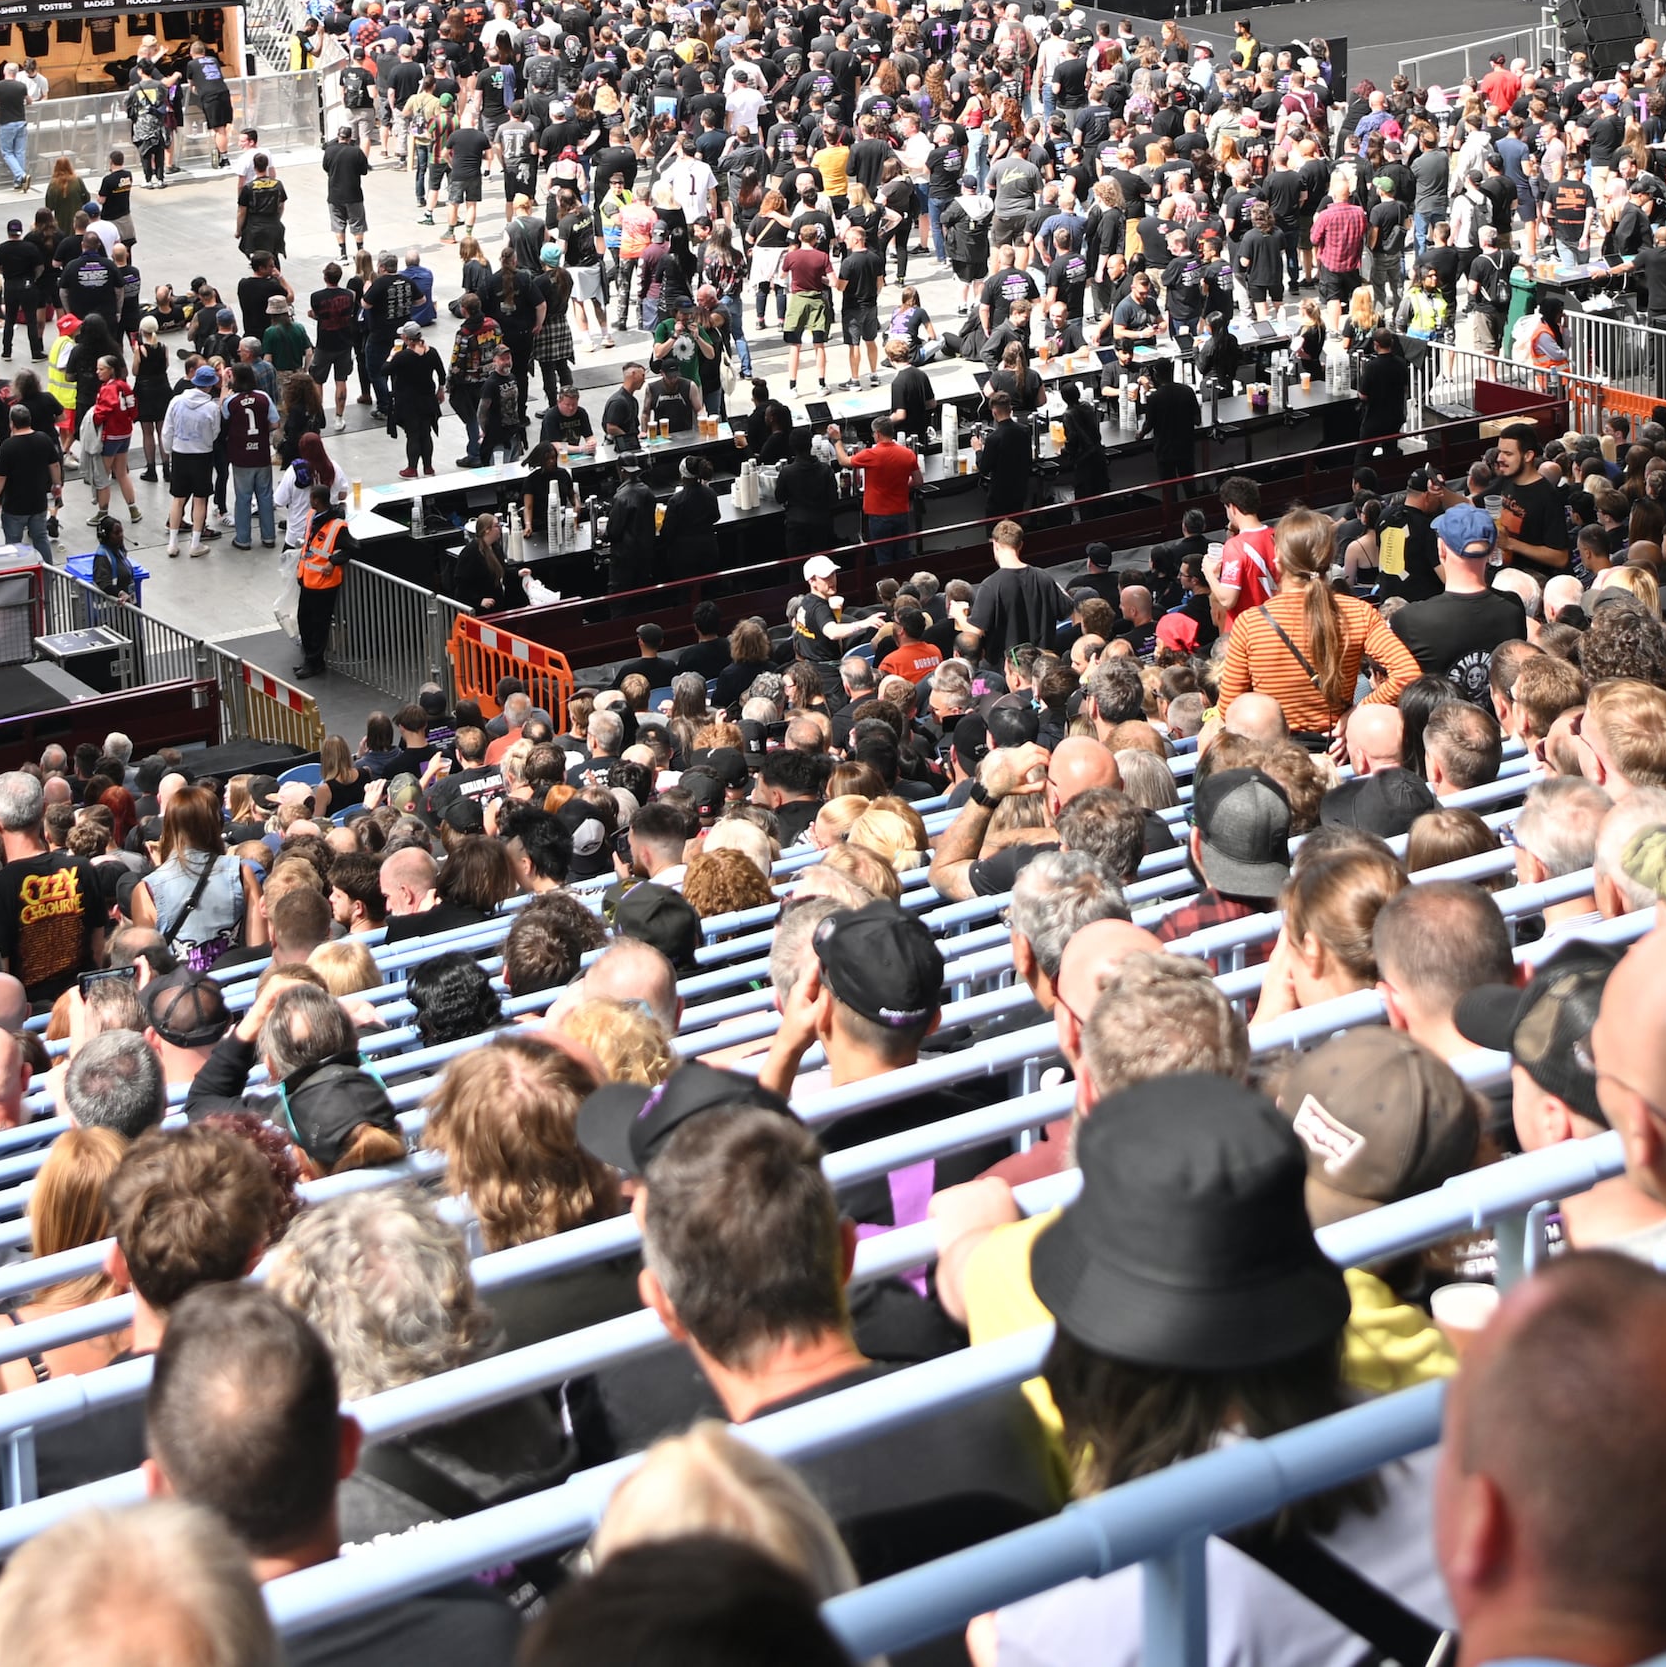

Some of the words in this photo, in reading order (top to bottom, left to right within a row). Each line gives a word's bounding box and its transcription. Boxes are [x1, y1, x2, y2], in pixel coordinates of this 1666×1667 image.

[38, 2, 73, 12] POSTERS
[244, 407, 259, 435] 1
[1457, 653, 1479, 670] THE
[19, 866, 79, 905] OZZY
[19, 892, 84, 925] OSBOURNE
